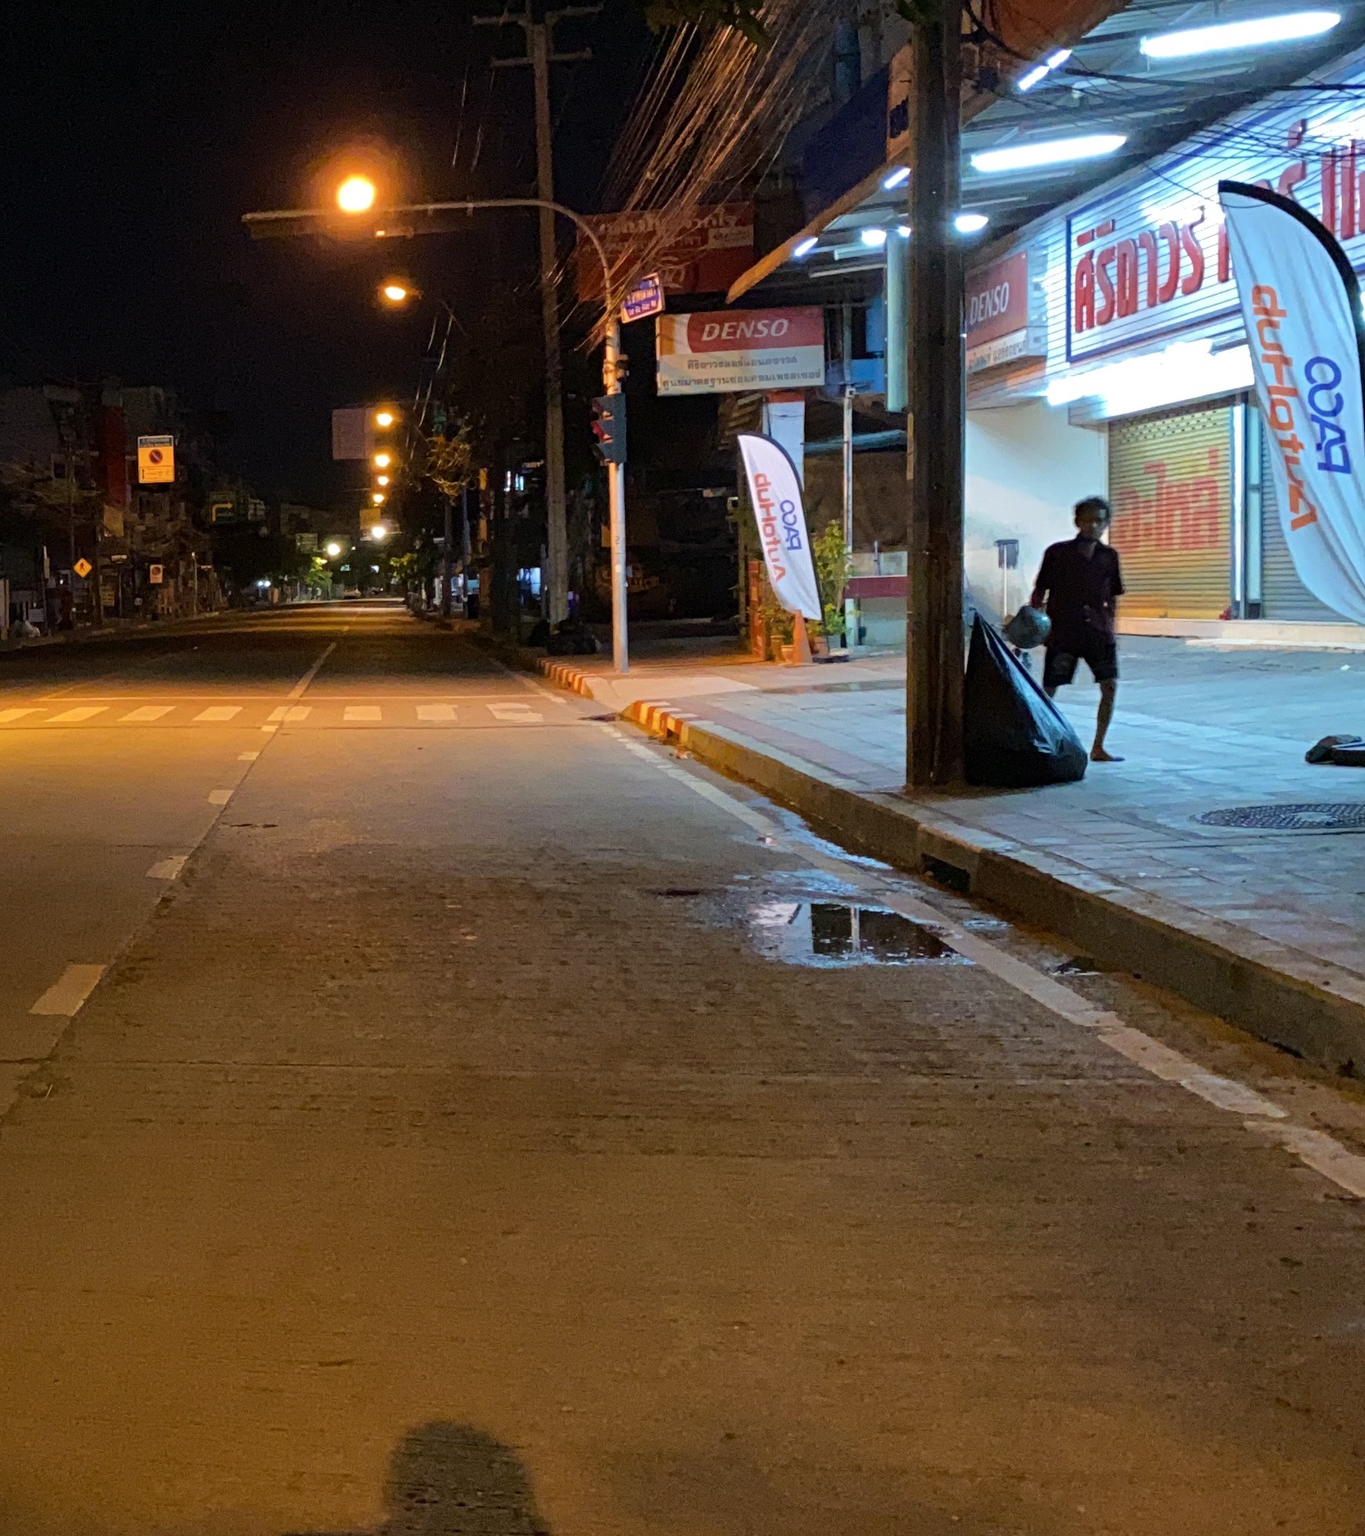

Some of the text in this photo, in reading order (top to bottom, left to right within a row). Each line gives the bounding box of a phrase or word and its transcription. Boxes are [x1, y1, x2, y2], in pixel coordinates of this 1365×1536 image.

[969, 281, 1010, 326] DENSO
[701, 318, 789, 342] DENSO
[1116, 446, 1220, 553] อะไหล่
